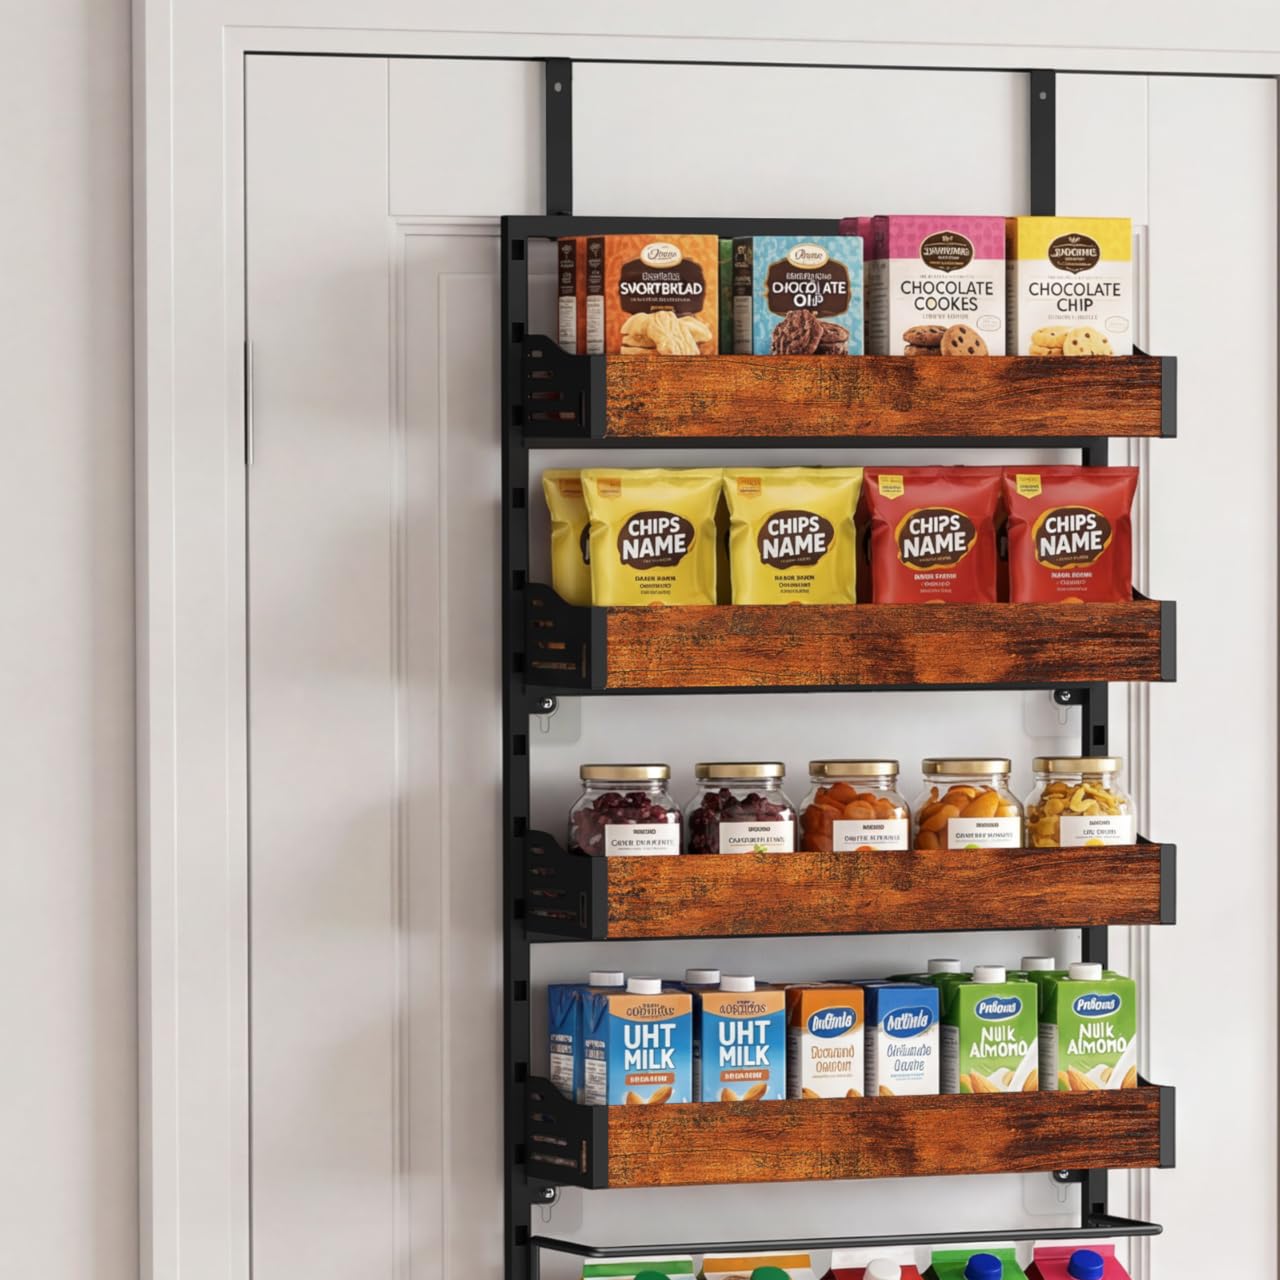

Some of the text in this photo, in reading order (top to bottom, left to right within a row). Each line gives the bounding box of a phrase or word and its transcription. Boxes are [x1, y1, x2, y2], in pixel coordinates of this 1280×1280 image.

[900, 280, 994, 296] CHOCOLATE
[1028, 282, 1121, 297] CHOCOLATE
[914, 297, 978, 312] COOKES
[1056, 298, 1094, 313] CHIP
[628, 516, 681, 537] CHIPS
[767, 516, 820, 537] CHIPS
[1045, 513, 1098, 534] CHIPS
[622, 533, 687, 560] NAME
[762, 532, 827, 560] NAME
[903, 532, 967, 559] NAME
[1040, 530, 1103, 557] NAME
[624, 1023, 677, 1050] UHT
[719, 1020, 771, 1046] UHT
[624, 1048, 676, 1071] MILK
[719, 1045, 770, 1068] MILK
